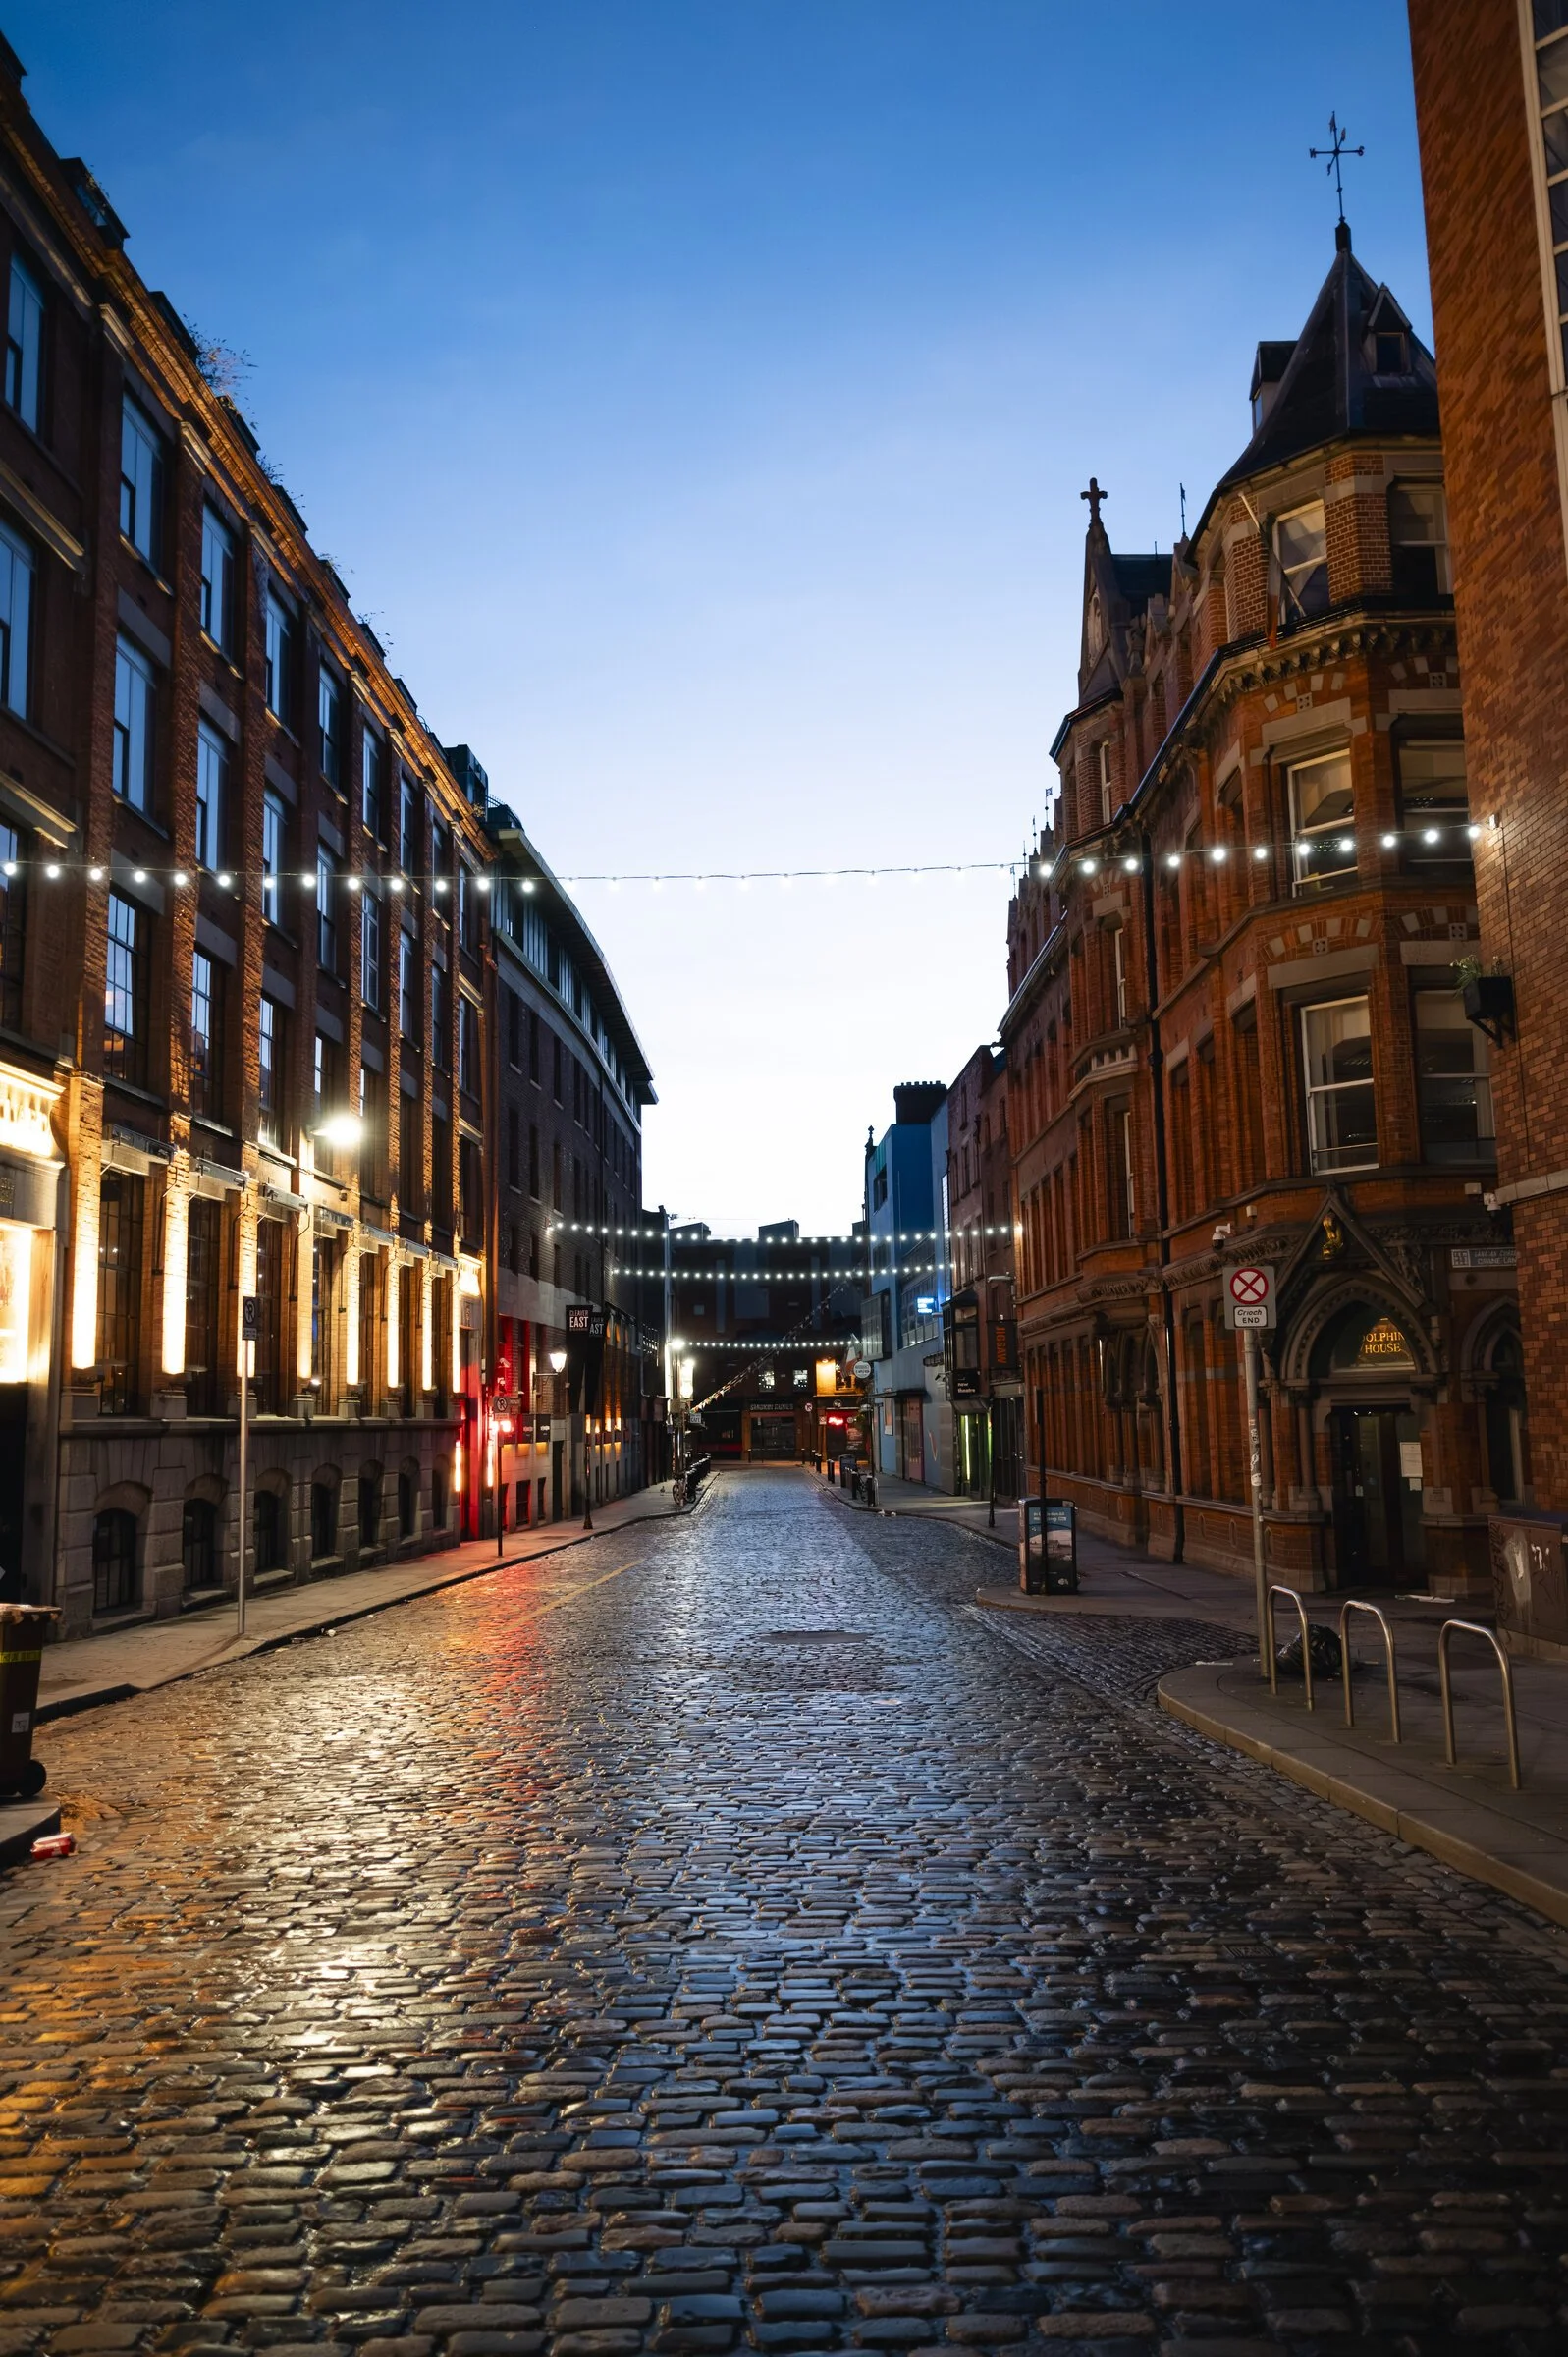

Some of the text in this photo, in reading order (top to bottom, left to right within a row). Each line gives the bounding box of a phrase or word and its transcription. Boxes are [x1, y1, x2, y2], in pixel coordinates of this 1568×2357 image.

[569, 1316, 589, 1328] EAST
[589, 1323, 605, 1334] AST
[995, 1326, 1007, 1364] JIGSAW
[1365, 1343, 1401, 1354] HOUSE
